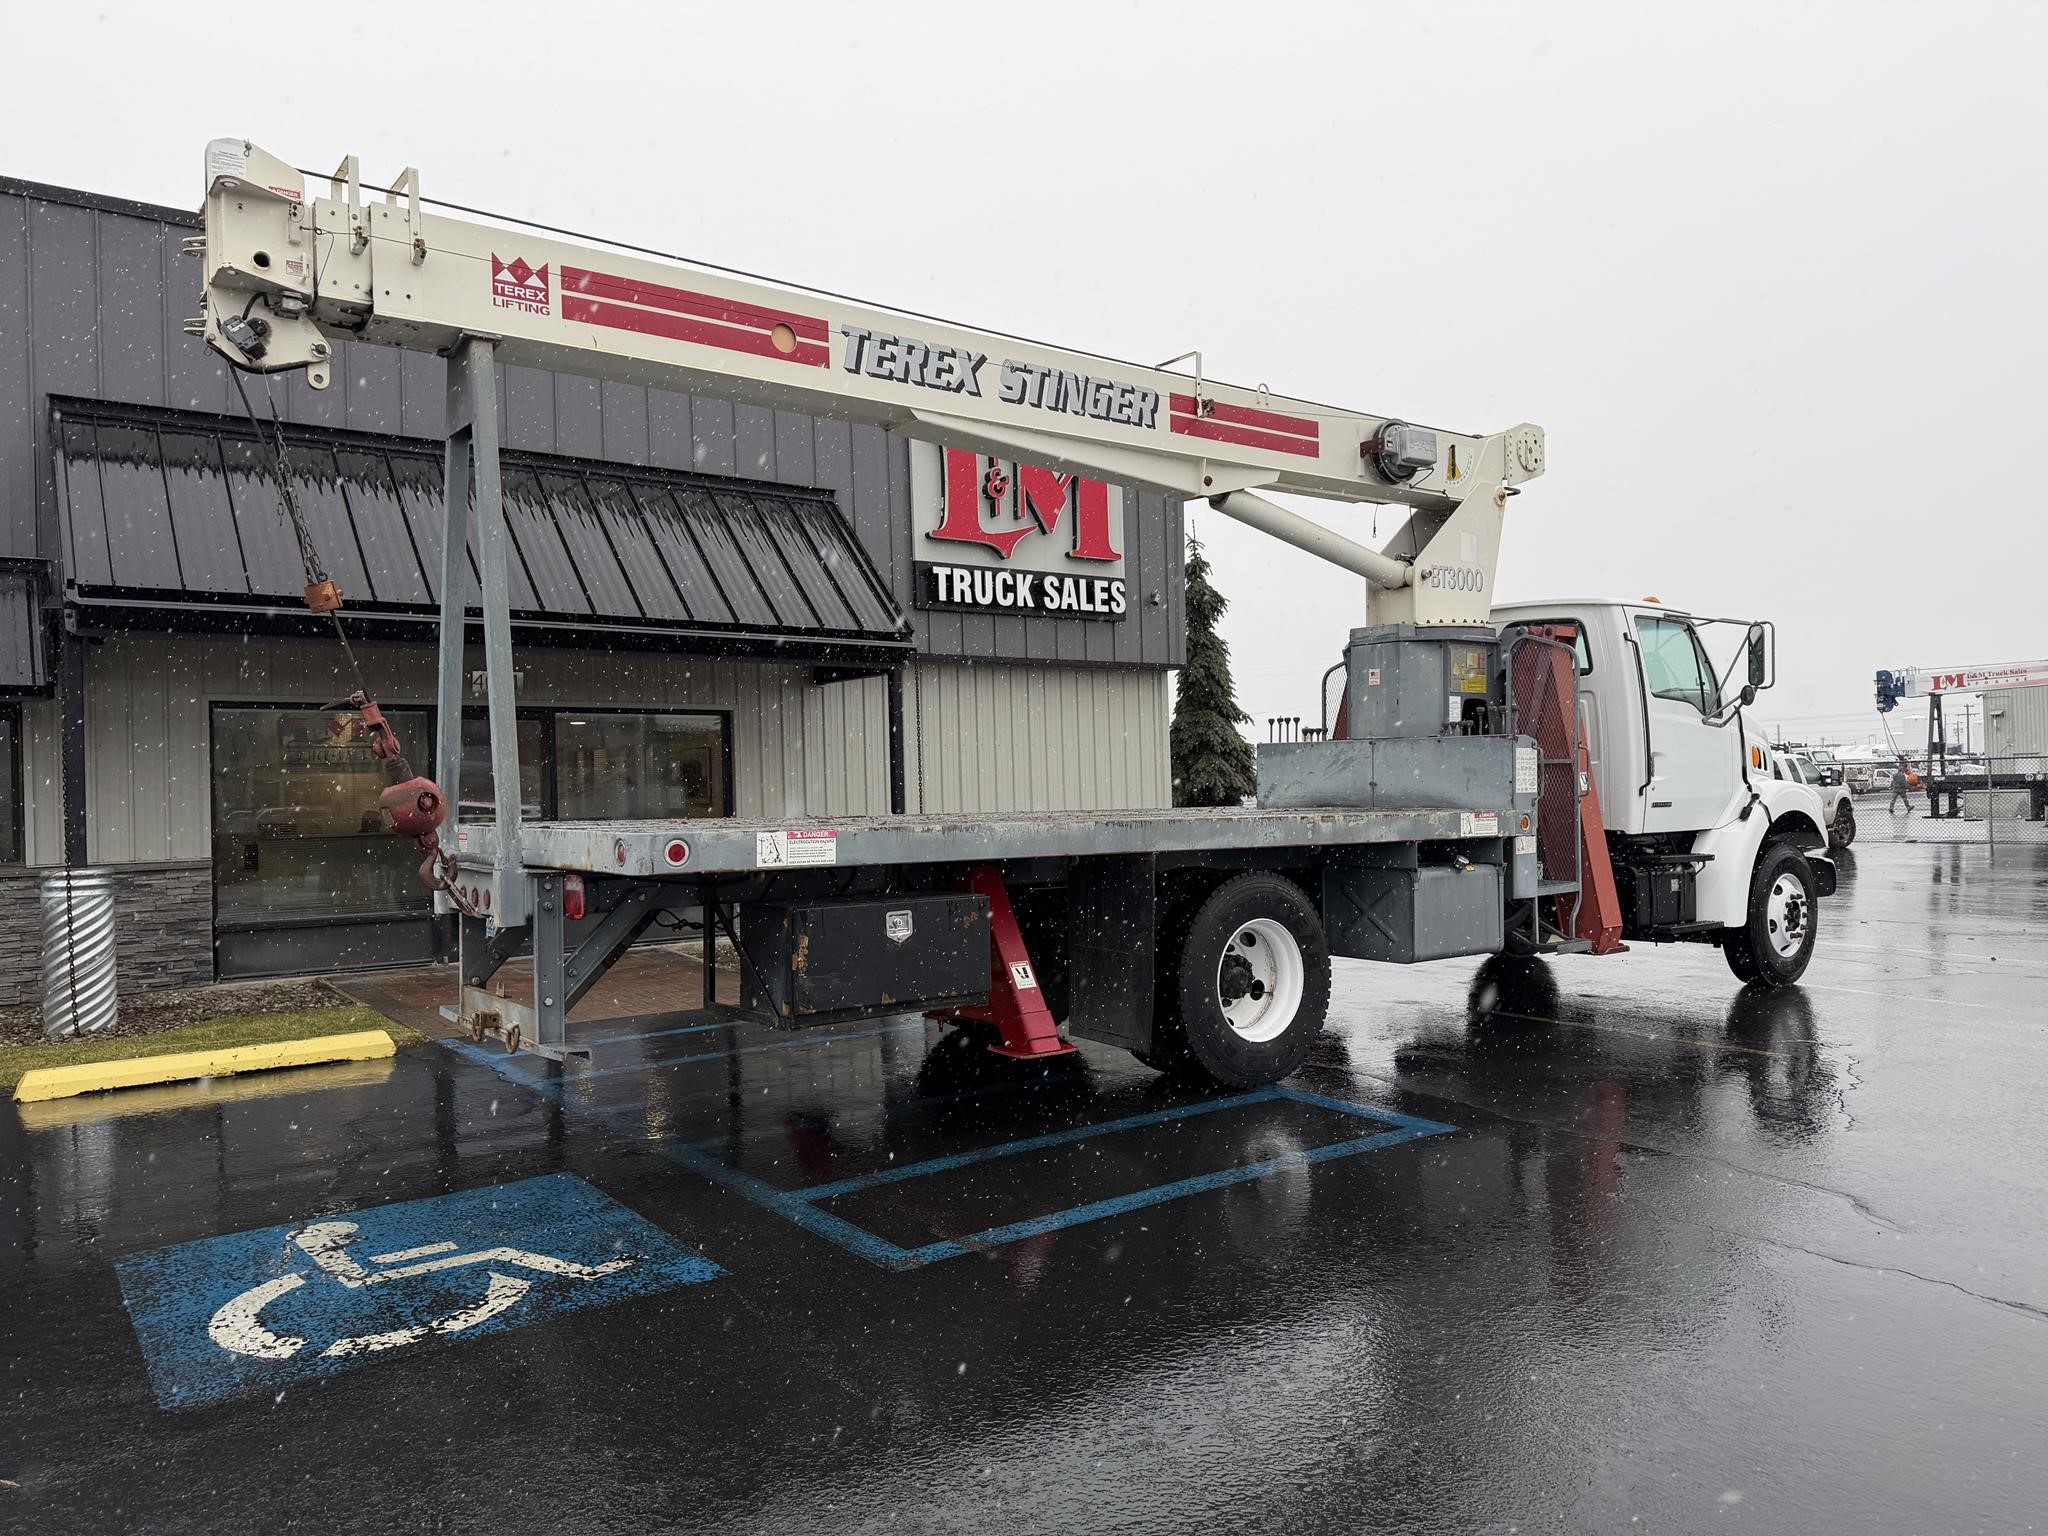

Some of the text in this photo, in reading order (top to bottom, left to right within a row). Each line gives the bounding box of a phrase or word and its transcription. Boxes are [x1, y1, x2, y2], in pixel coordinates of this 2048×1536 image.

[494, 282, 548, 304] TEREX
[493, 297, 550, 316] LIFTING
[841, 324, 1160, 430] TEREX STINGER
[932, 566, 1127, 614] TRUCK SALES
[1431, 564, 1484, 593] BT3000
[1988, 670, 2008, 678] Truck
